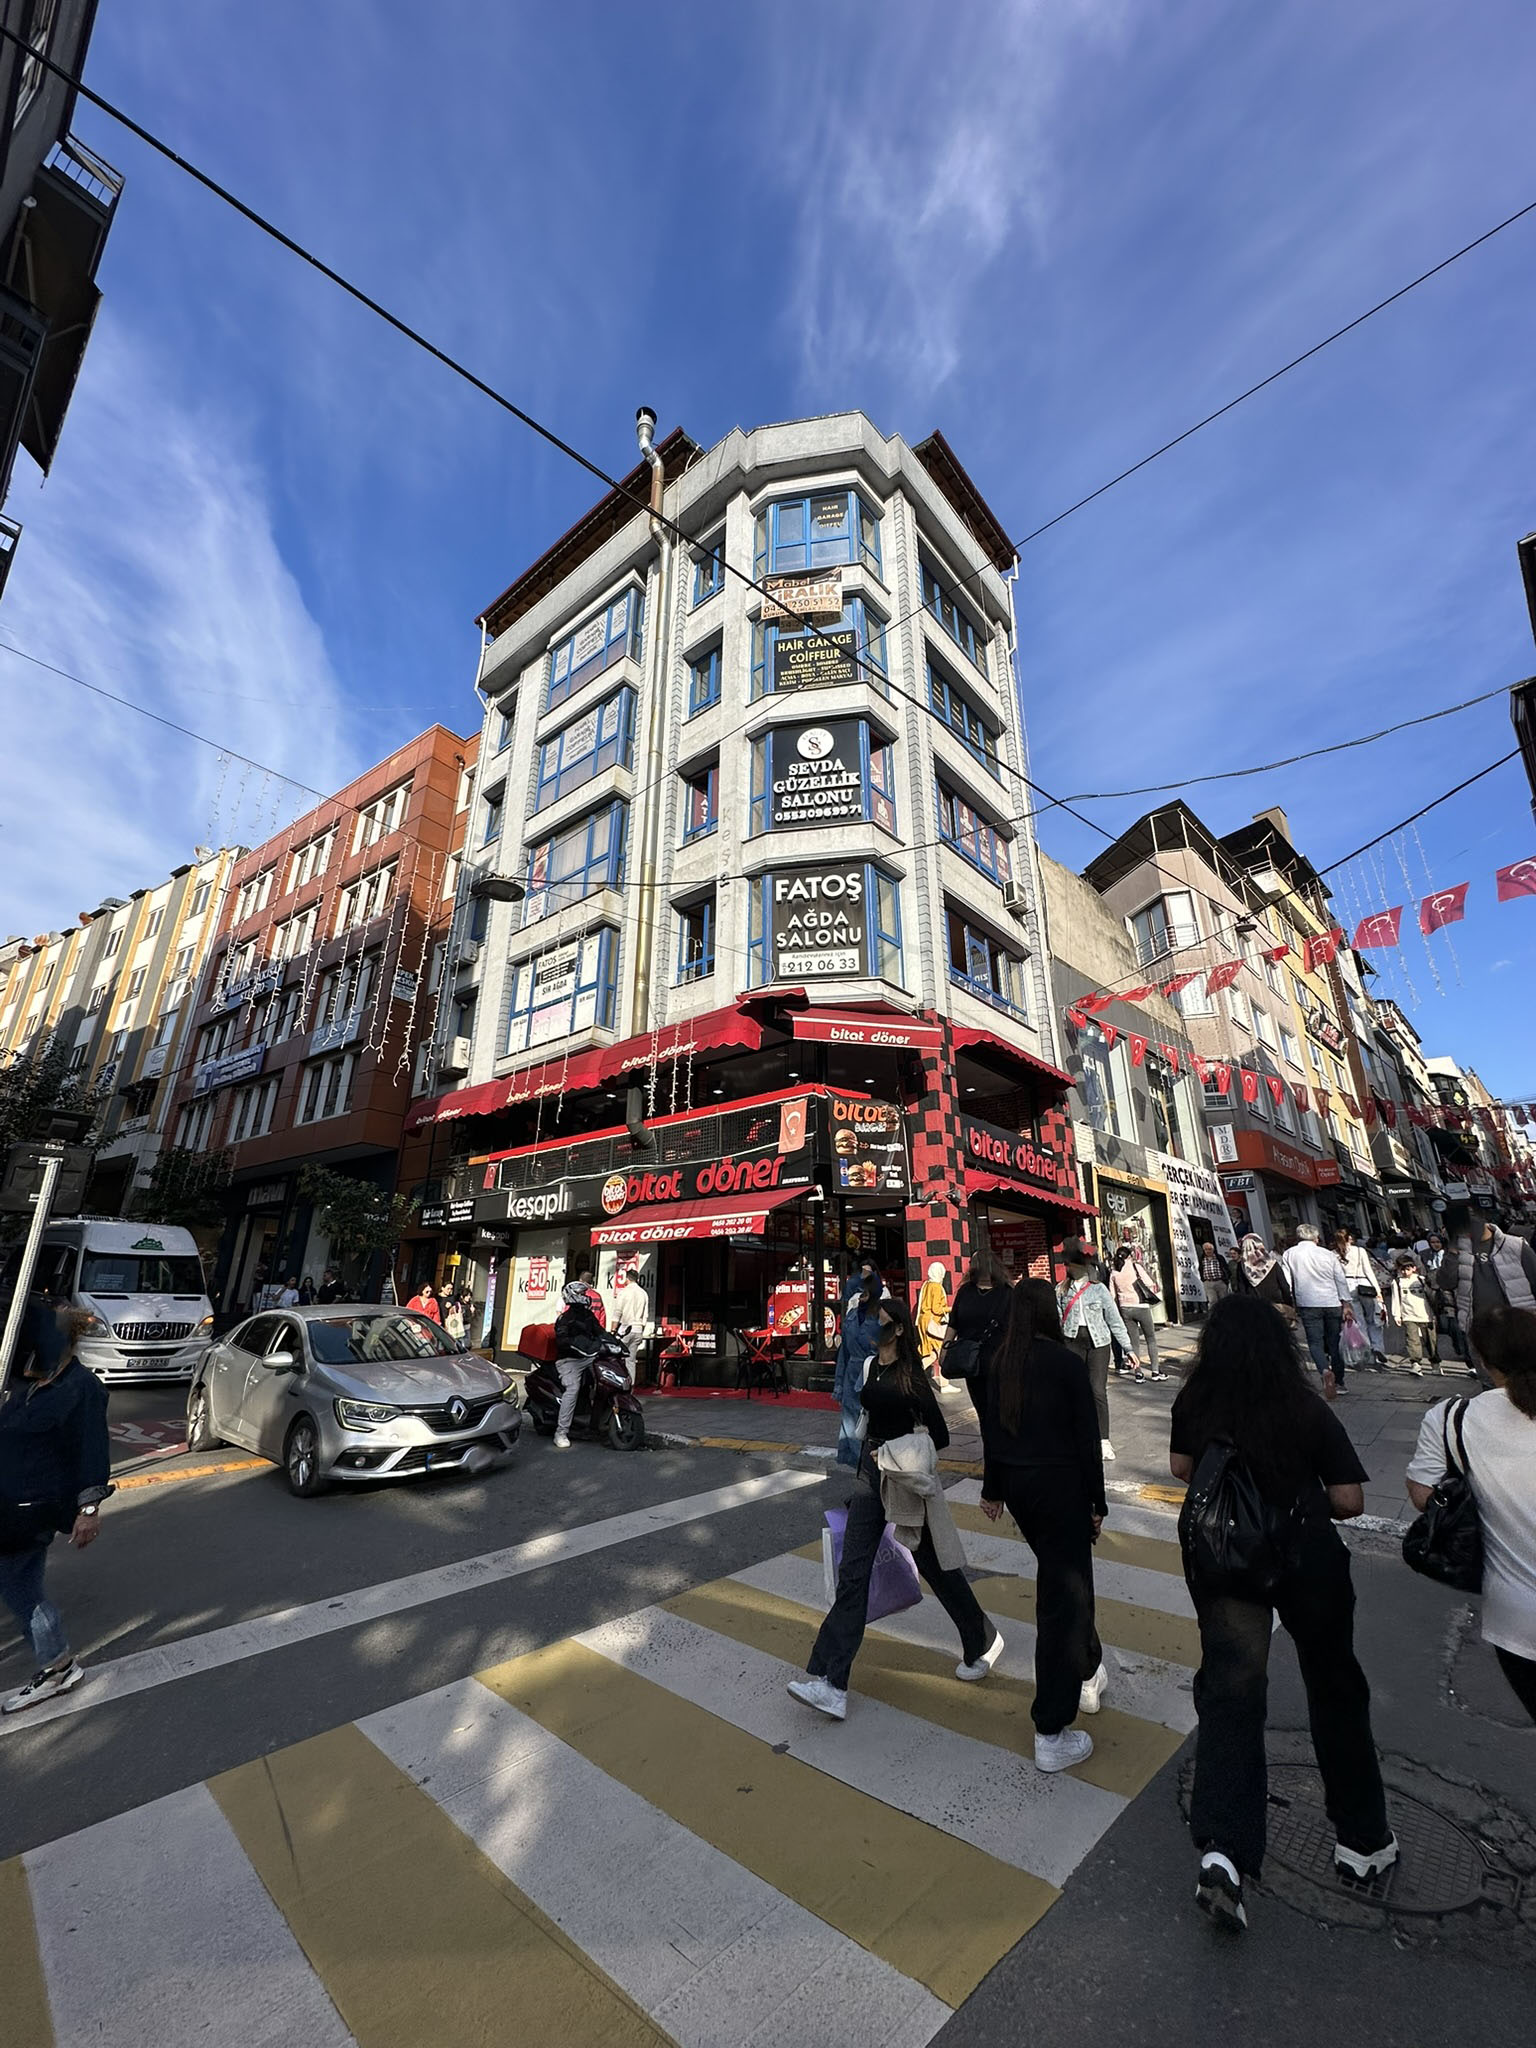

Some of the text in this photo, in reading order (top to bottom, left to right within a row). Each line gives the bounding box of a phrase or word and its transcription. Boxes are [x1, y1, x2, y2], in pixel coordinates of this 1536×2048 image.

[778, 639, 805, 652] HAİR
[789, 648, 841, 664] COİFFEUR
[788, 758, 846, 776] SEVDA
[773, 771, 861, 793] GÜZELLİK
[781, 789, 854, 808] SALONU
[775, 873, 862, 901] FATOŞ
[787, 909, 849, 929] AĞDA
[776, 926, 862, 948] SALONU
[788, 961, 813, 972] 212
[818, 960, 835, 970] 06
[839, 958, 856, 969] 33
[830, 1028, 911, 1045] bitat döner
[833, 1099, 887, 1122] bitat
[969, 1126, 1057, 1182] bitat döner
[627, 1155, 787, 1203] bitat döner
[507, 1184, 568, 1220] keşaplı
[598, 1225, 694, 1243] bitat döner
[530, 1267, 547, 1288] 50
